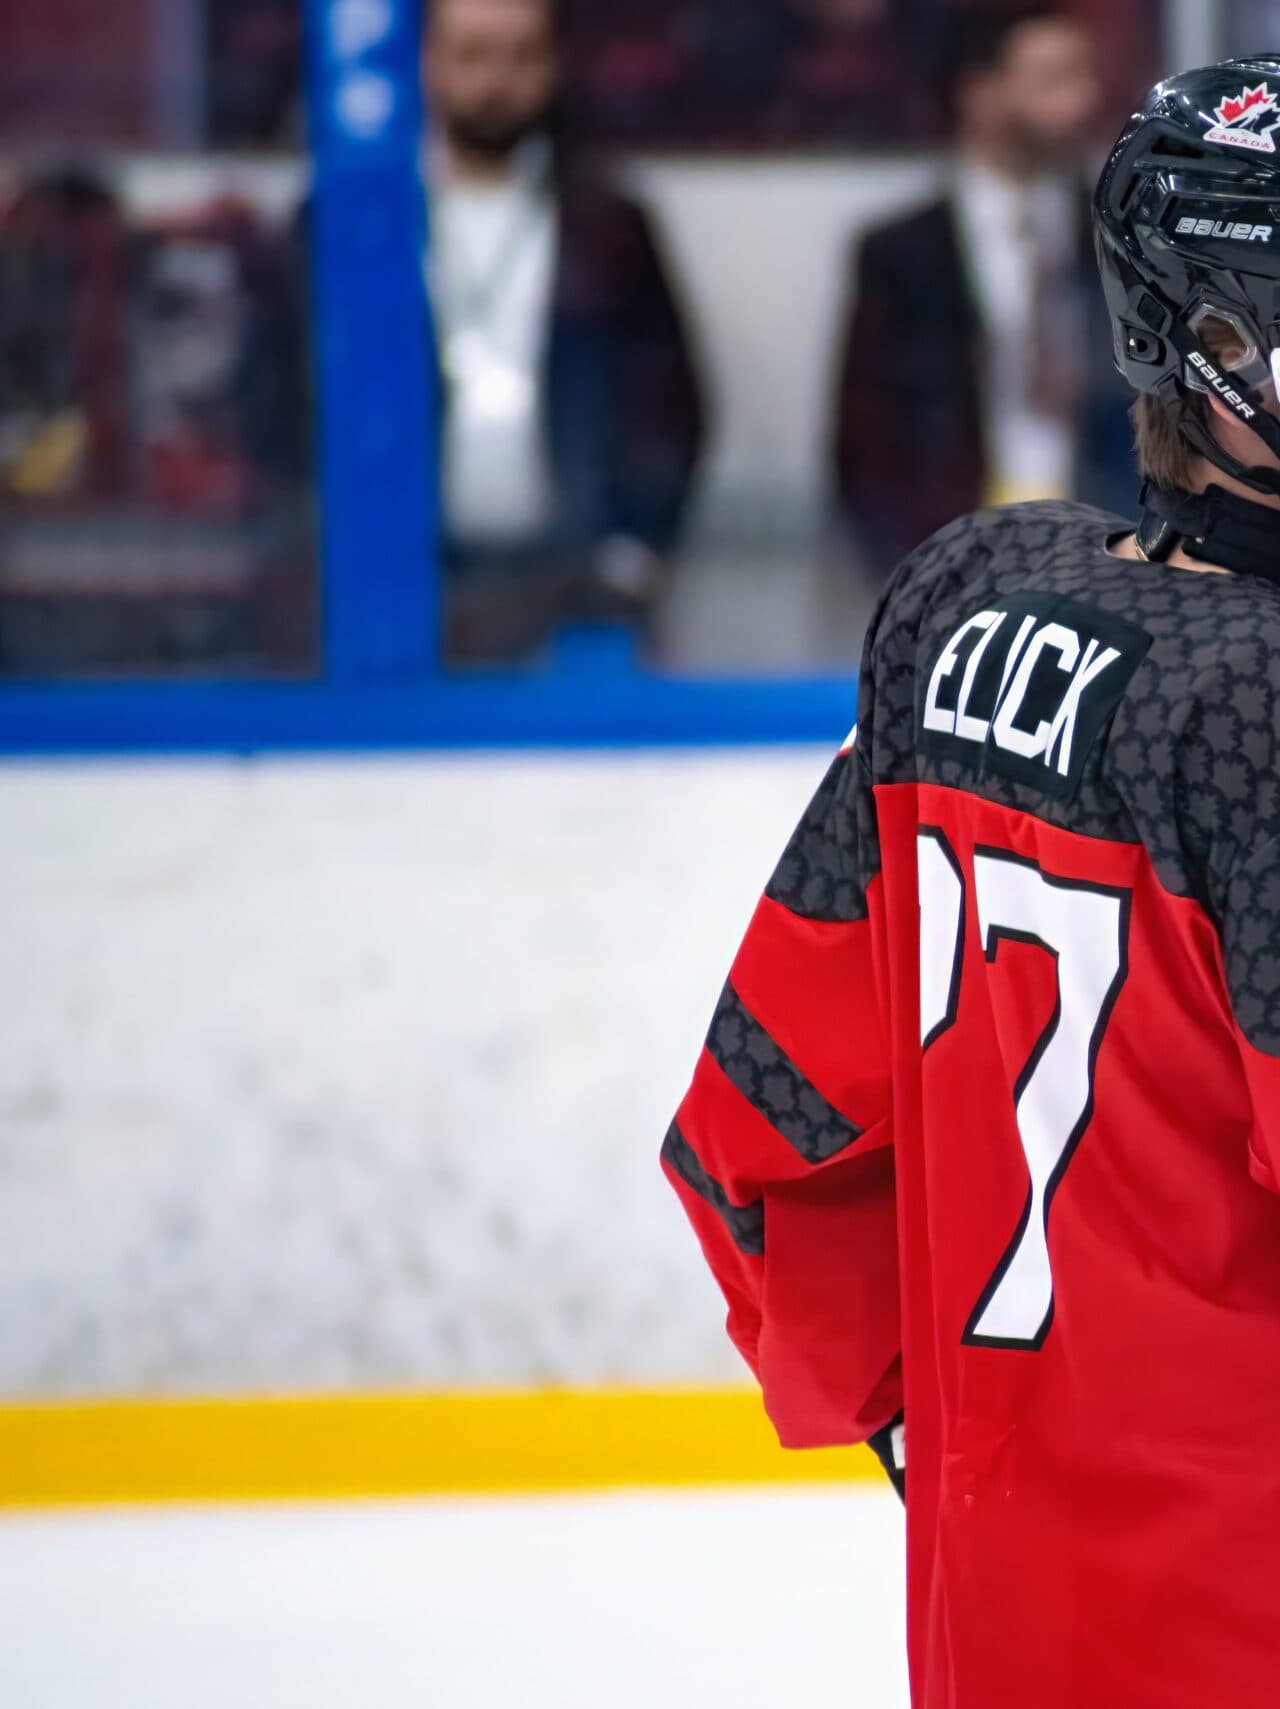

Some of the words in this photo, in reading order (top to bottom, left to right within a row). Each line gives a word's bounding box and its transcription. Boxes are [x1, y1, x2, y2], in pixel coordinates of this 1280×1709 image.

[1208, 132, 1270, 150] CANADA
[1175, 217, 1273, 242] BAUER
[1187, 351, 1255, 419] BAUER
